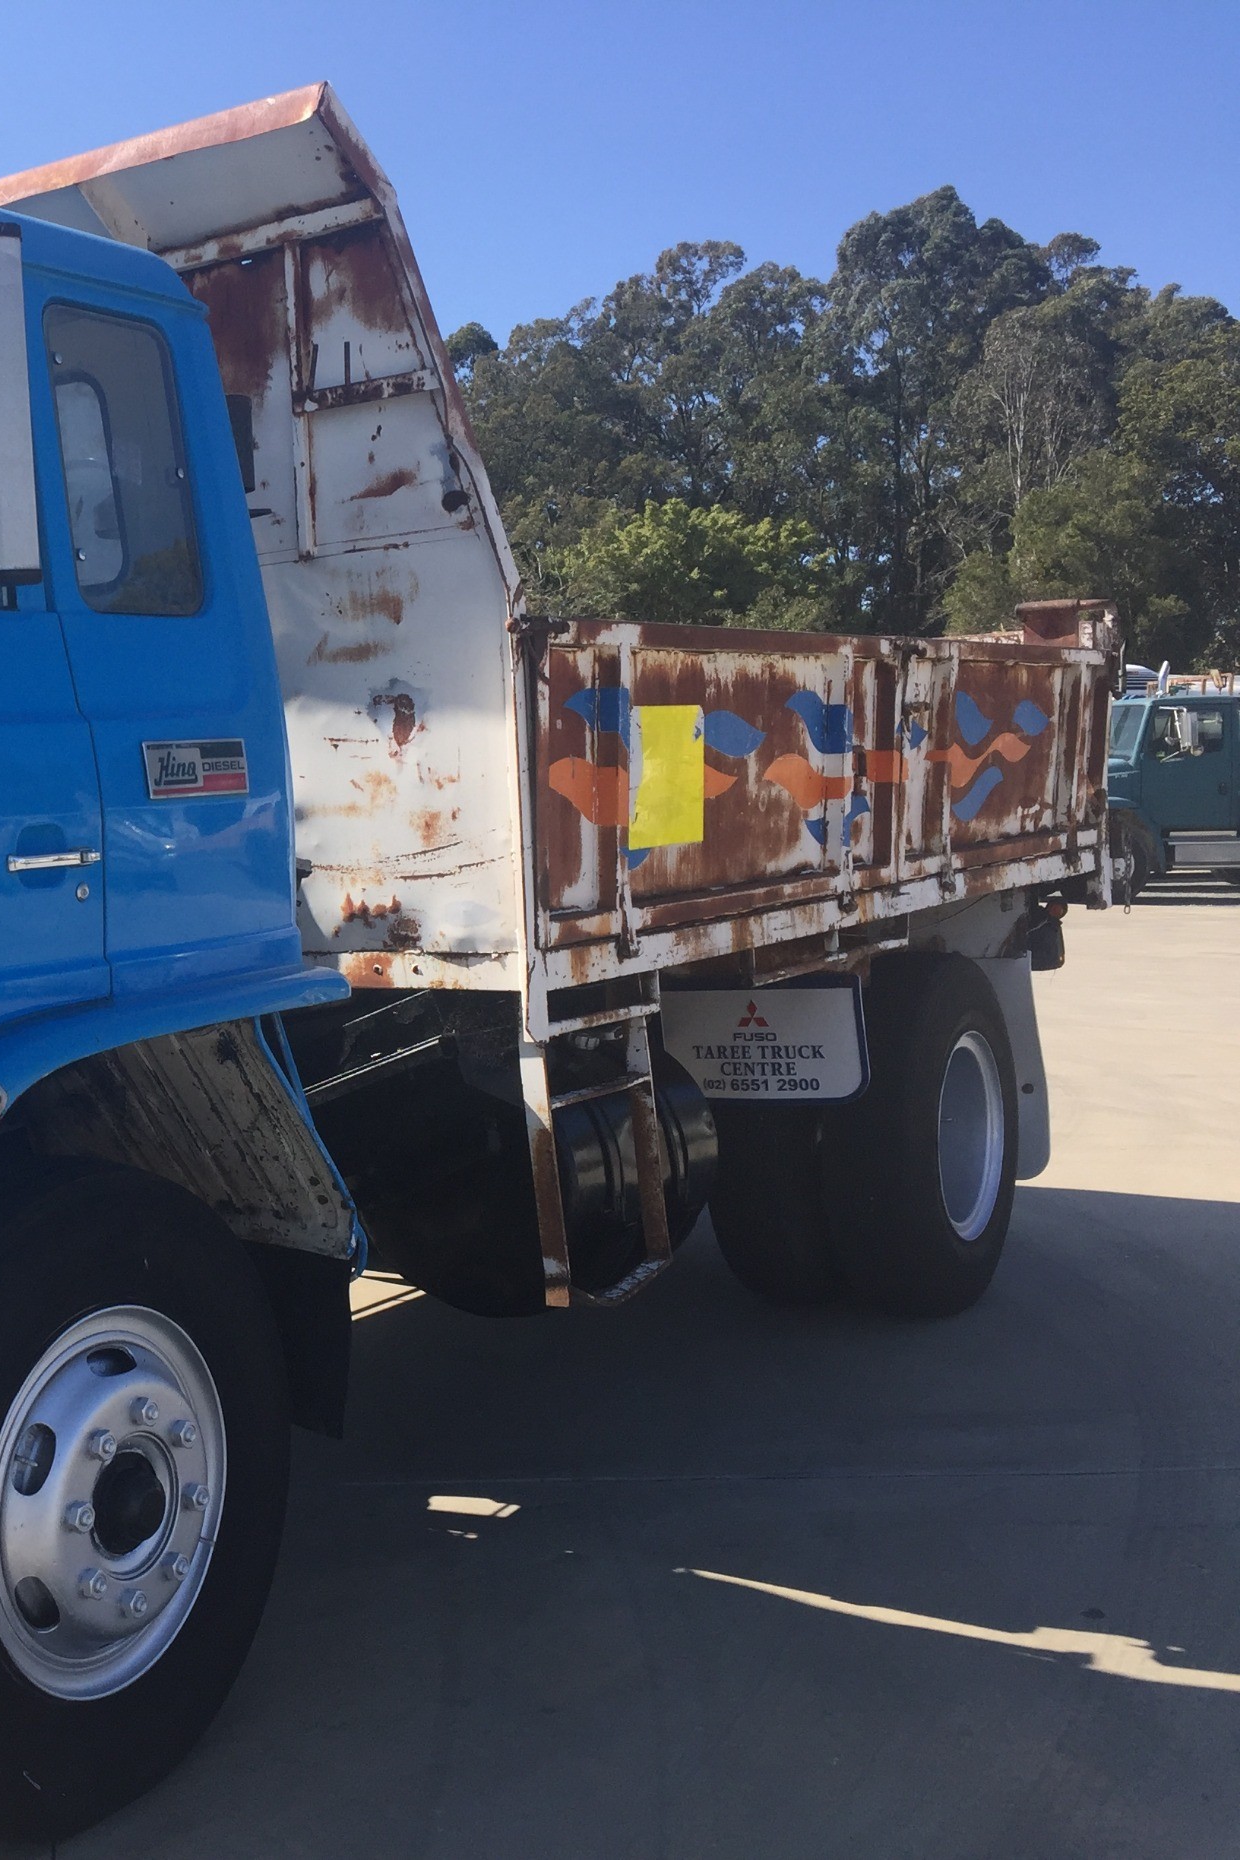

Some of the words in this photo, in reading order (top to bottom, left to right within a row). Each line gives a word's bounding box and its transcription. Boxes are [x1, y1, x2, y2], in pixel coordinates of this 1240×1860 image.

[154, 751, 198, 787] Hino
[202, 760, 245, 772] DIESEL
[733, 1032, 777, 1042] FUSO
[693, 1045, 752, 1060] TAREE
[757, 1045, 825, 1060] TRUCK
[720, 1061, 797, 1077] CENTRE
[703, 1079, 726, 1092] (02)
[731, 1079, 769, 1092] 6551
[777, 1078, 820, 1092] 2900
